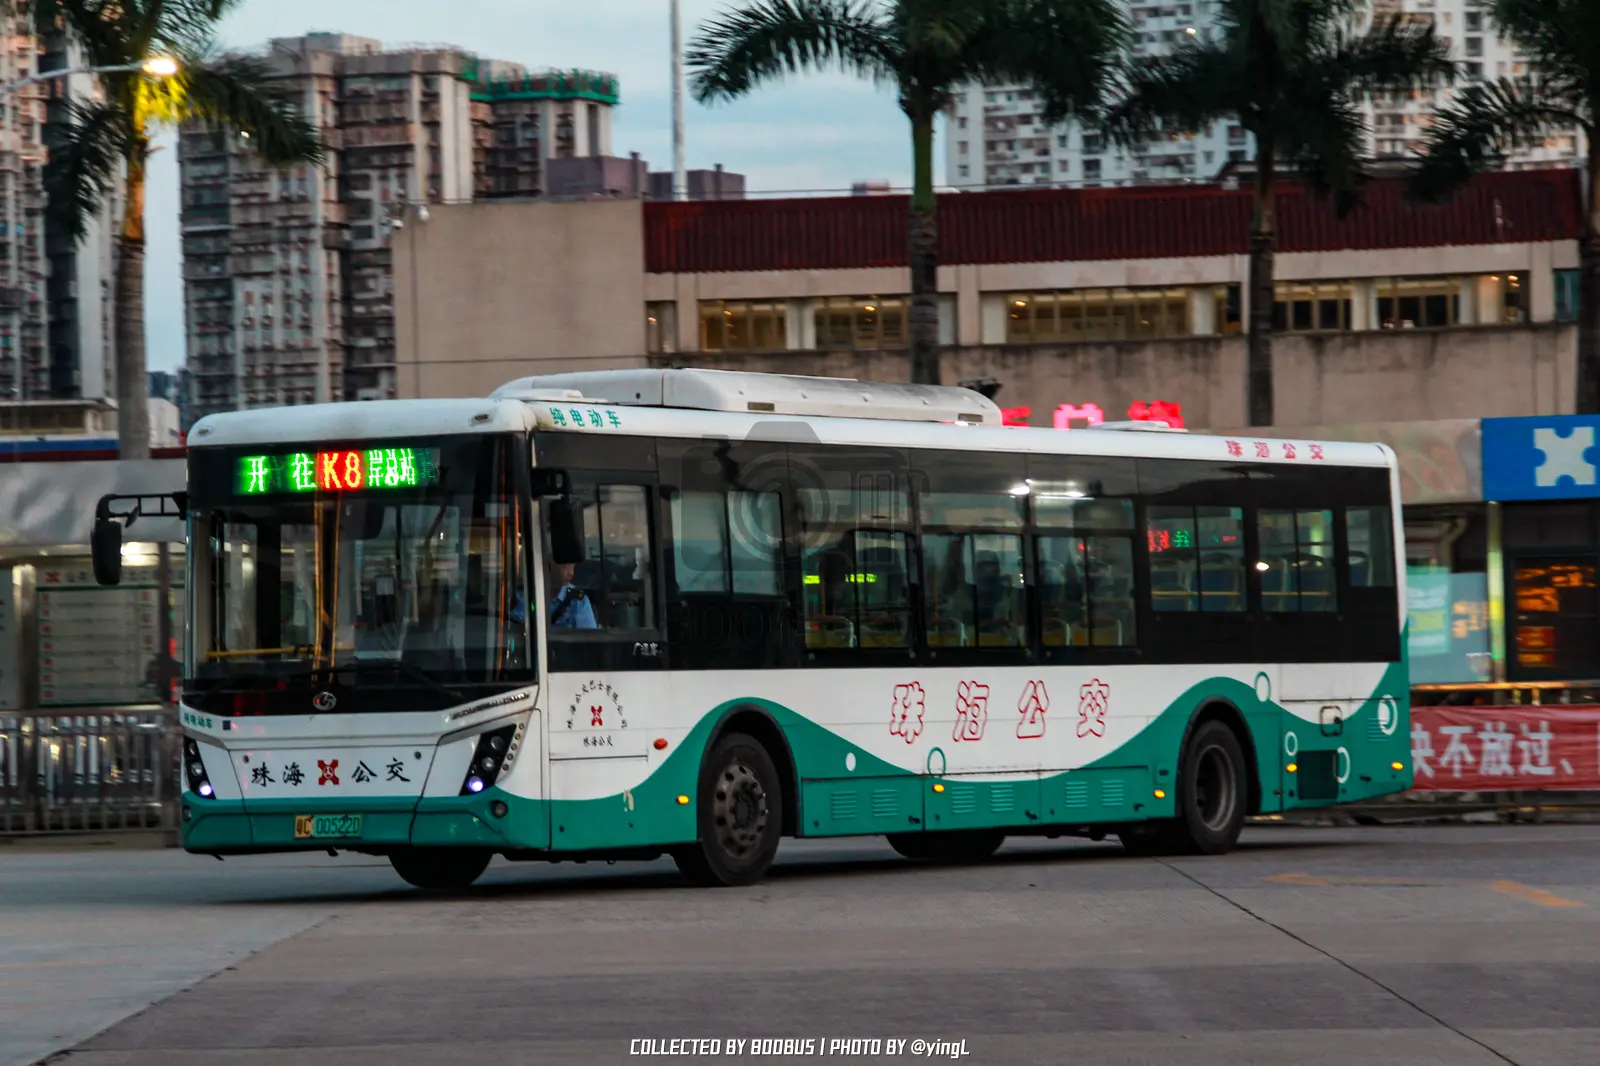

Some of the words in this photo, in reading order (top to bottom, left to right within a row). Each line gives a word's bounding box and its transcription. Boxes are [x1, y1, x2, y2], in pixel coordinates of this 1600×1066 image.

[549, 407, 621, 428] 纯电动车
[323, 452, 361, 489] K8
[251, 761, 305, 787] 珠海
[351, 757, 411, 783] 公交
